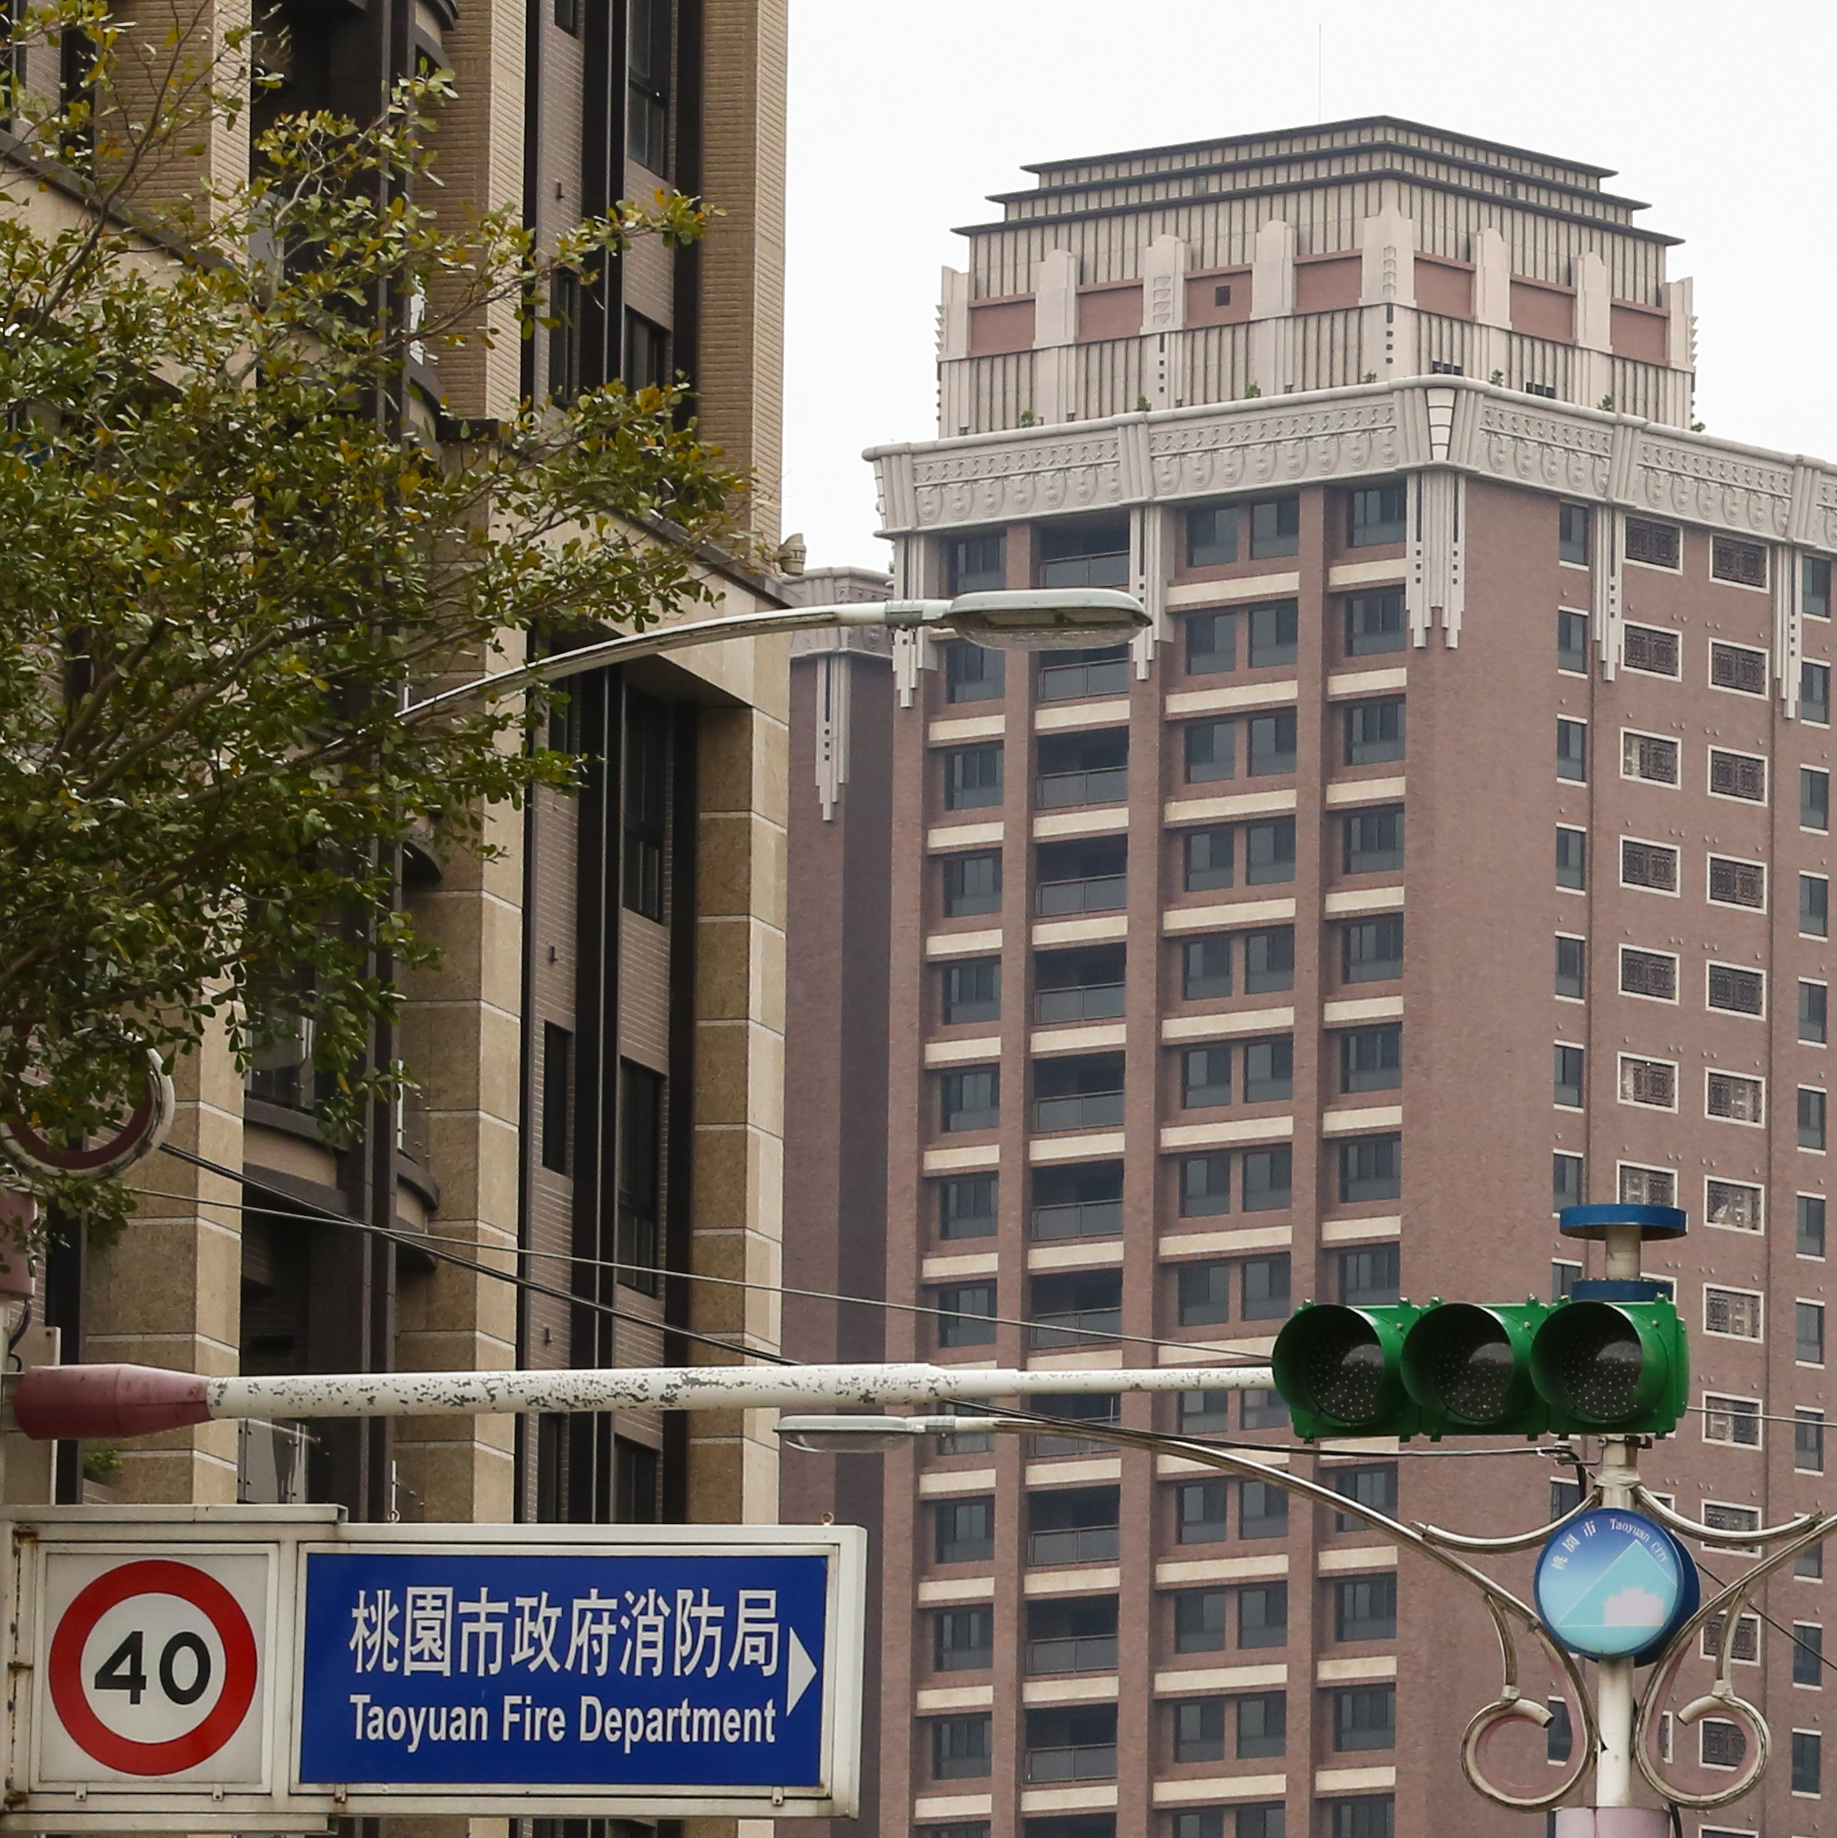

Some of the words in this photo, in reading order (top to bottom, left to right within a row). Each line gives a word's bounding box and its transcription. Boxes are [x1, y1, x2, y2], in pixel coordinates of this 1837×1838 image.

[93, 1630, 211, 1705] 40
[349, 1586, 780, 1679] 桃園市政府消防局
[349, 1694, 488, 1754] Taoyuan
[503, 1695, 566, 1743] Fire
[579, 1695, 776, 1754] Department
